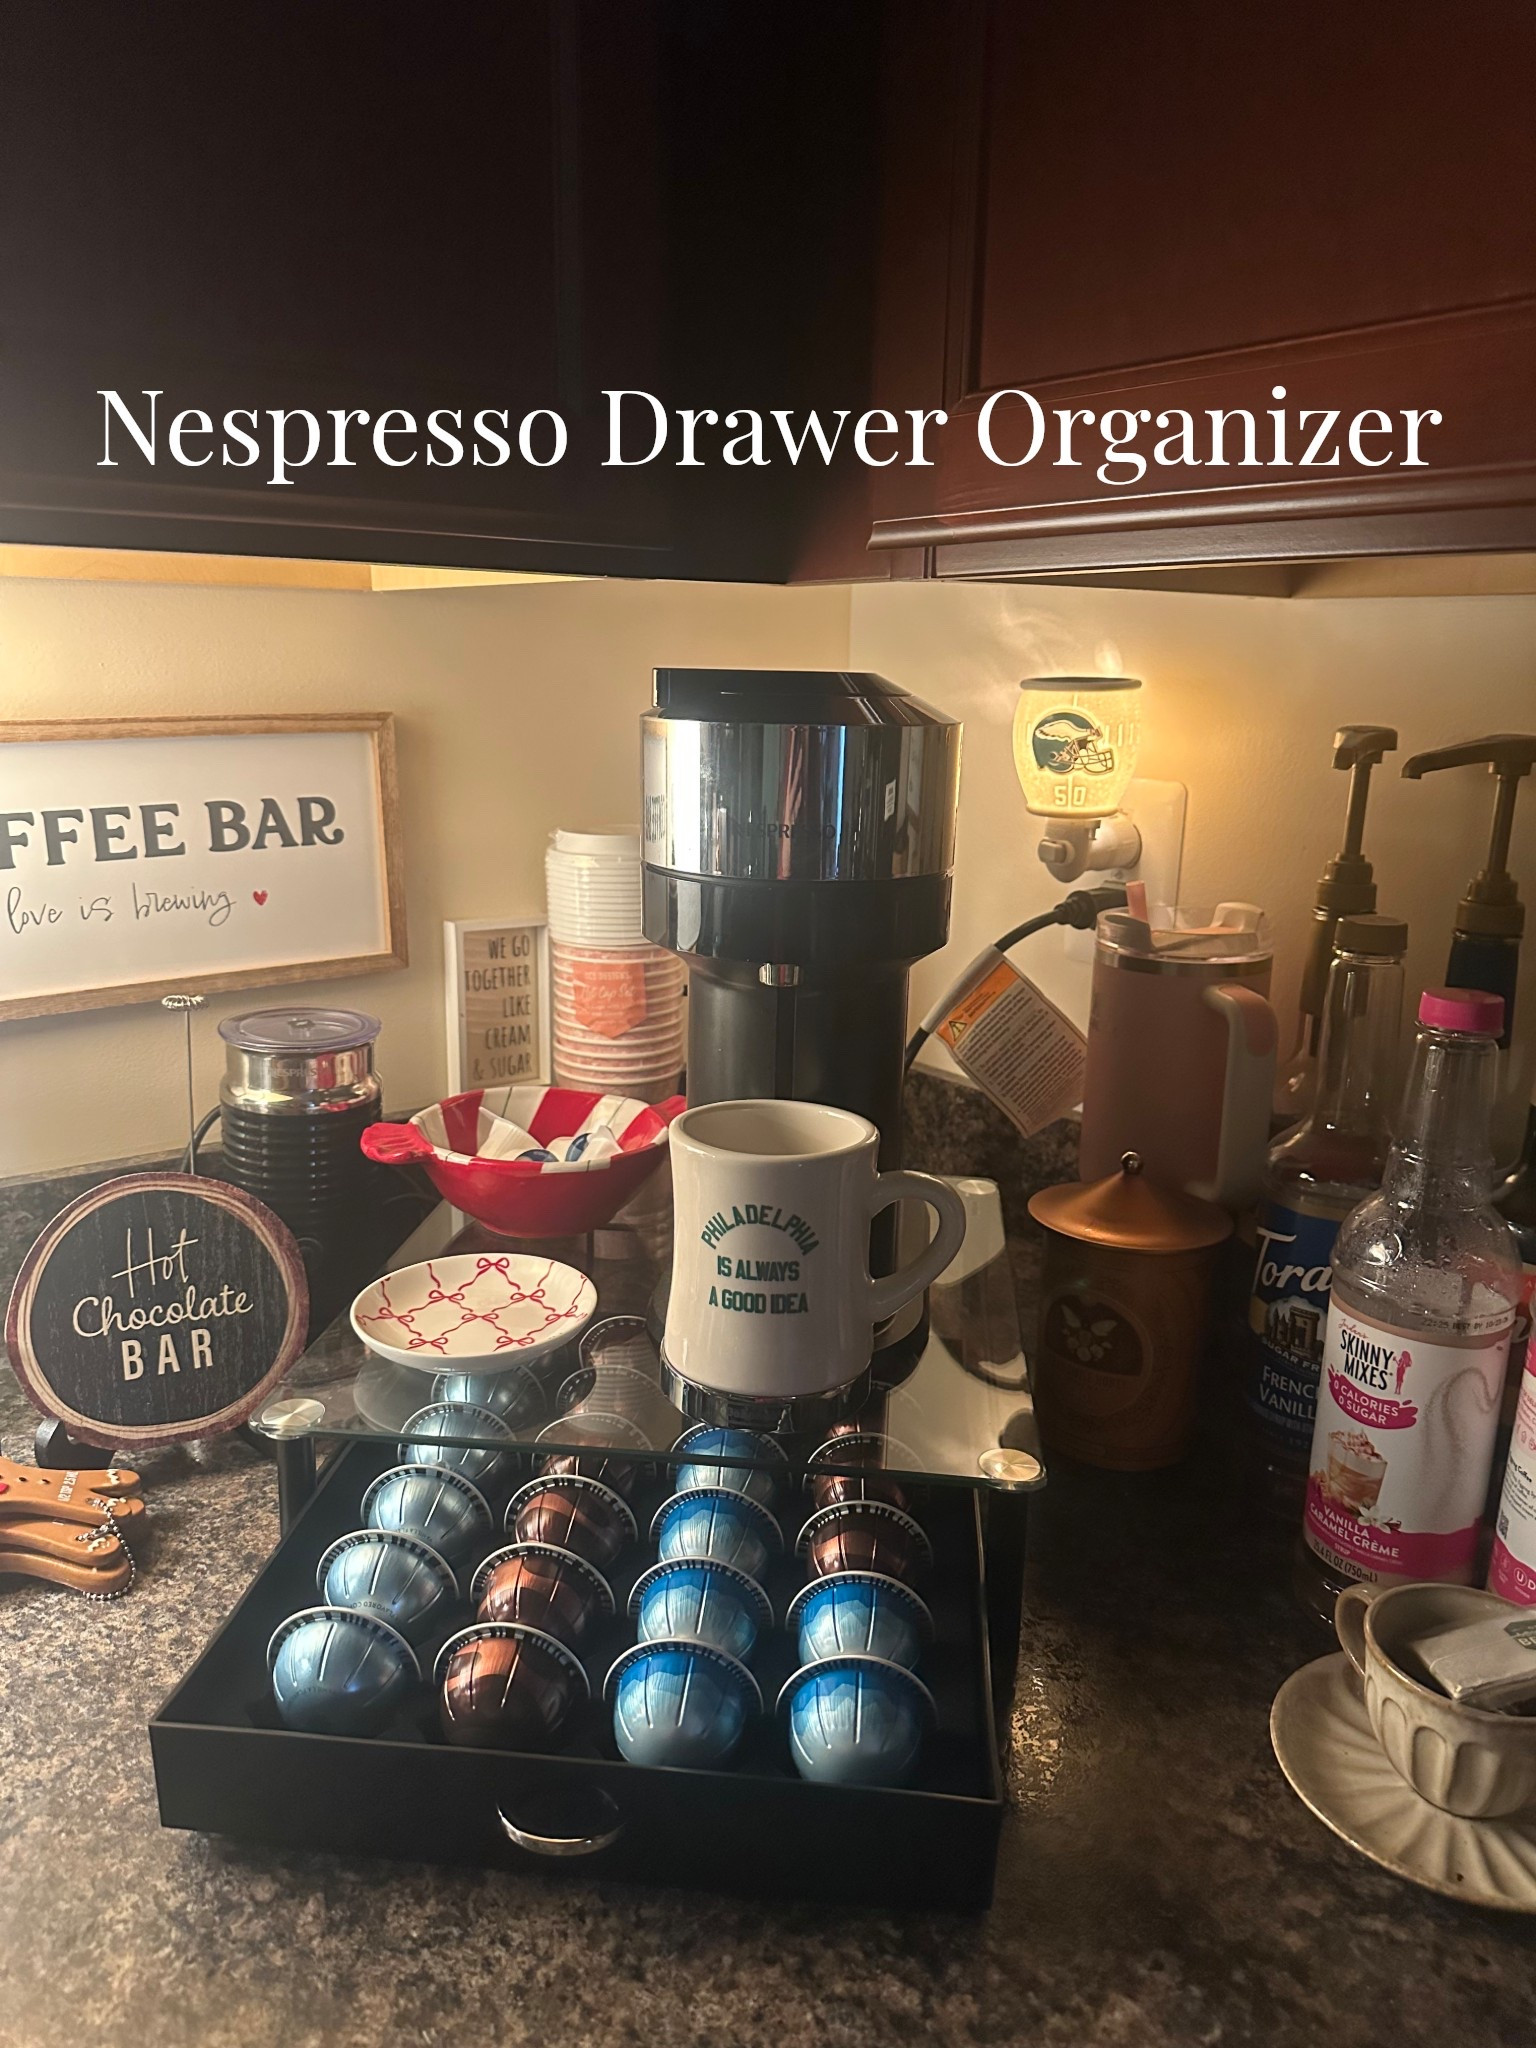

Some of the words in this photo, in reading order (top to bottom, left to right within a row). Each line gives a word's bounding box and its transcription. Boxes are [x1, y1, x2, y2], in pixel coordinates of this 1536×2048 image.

[204, 796, 345, 853] BAR
[7, 886, 63, 934] love
[79, 896, 115, 922] is
[132, 882, 237, 926] brewing
[487, 937, 506, 960] WE
[511, 934, 530, 958] GO
[464, 964, 531, 992] TOGETHER
[502, 994, 531, 1019] LIKE
[484, 1024, 531, 1050] CREAM
[472, 1059, 484, 1081] &
[490, 1052, 533, 1079] SUGAR
[701, 1204, 820, 1256] PHILADELPHIA
[112, 1227, 199, 1299] Hot
[717, 1255, 732, 1277] IS
[735, 1259, 800, 1282] ALWAYS
[1252, 1226, 1332, 1292] Tora
[72, 1284, 254, 1338] Chocolate
[708, 1286, 718, 1307] A
[721, 1289, 767, 1314] GOOD
[770, 1292, 809, 1314] IDEA
[120, 1328, 215, 1382] BAR
[1340, 1329, 1394, 1370] SKINNY
[1262, 1365, 1319, 1399] FRENC
[1344, 1353, 1388, 1390] MIXES
[1340, 1385, 1399, 1417] CALORIES
[1346, 1400, 1387, 1425] SUGAR
[1310, 1502, 1351, 1541] CARAMEL
[1352, 1535, 1400, 1558] CRÈME
[1324, 1505, 1370, 1539] VANILLA
[1333, 1557, 1344, 1570] OZ
